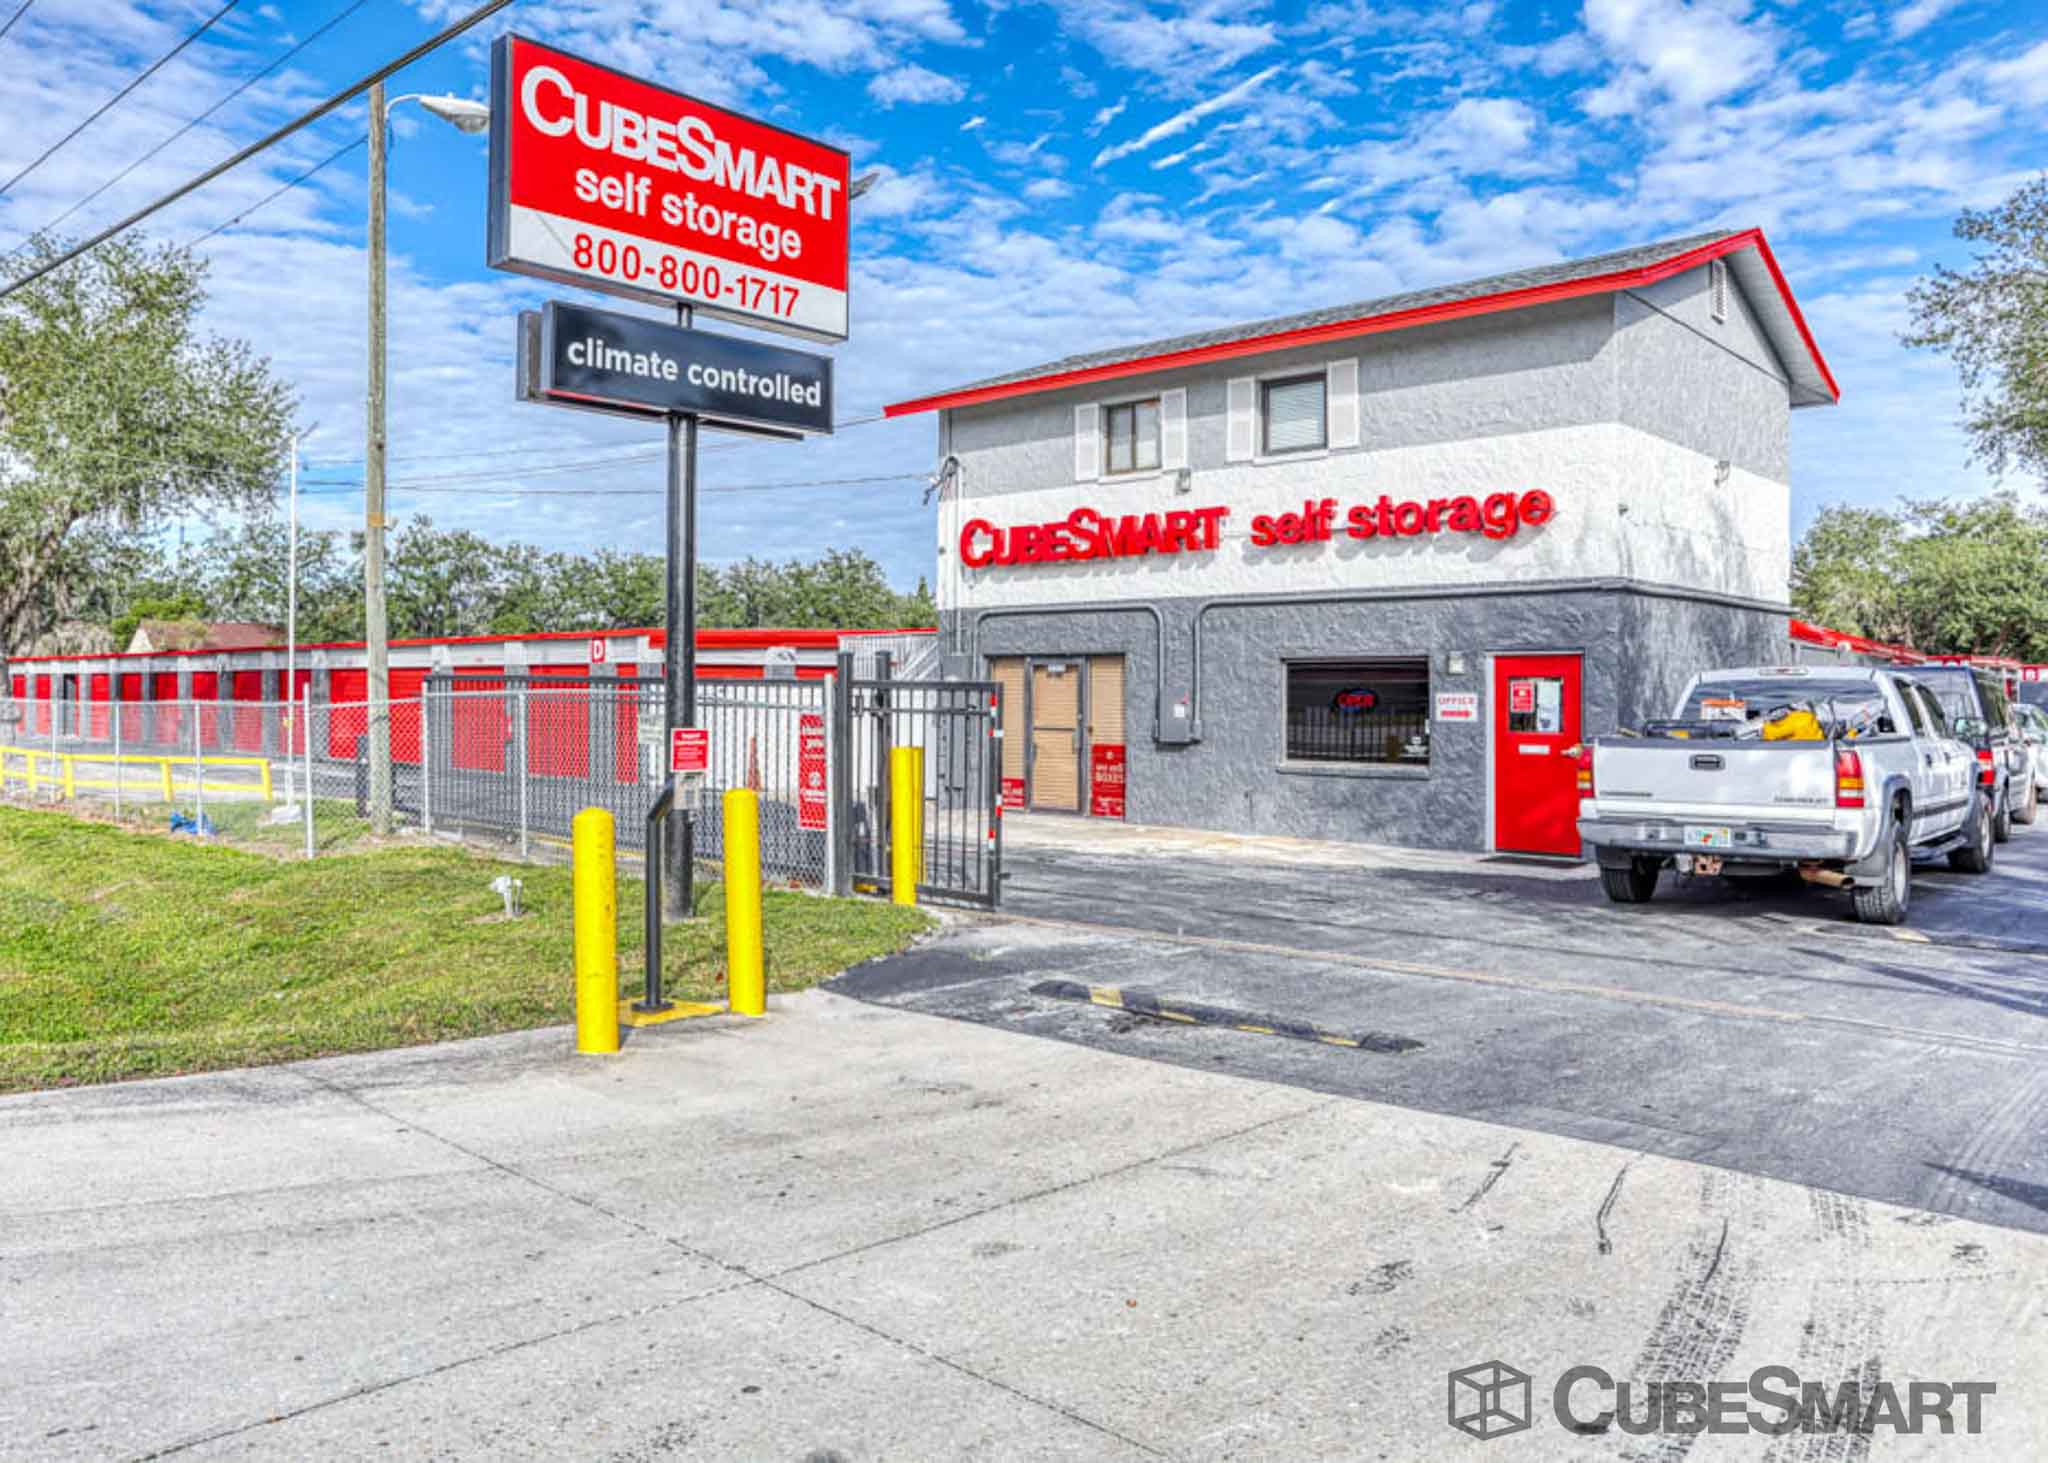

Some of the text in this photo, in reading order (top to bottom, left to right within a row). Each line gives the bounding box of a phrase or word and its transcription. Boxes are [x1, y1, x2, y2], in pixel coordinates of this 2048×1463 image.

[574, 167, 802, 262] self storage
[572, 232, 801, 318] 800-800-1717
[567, 338, 822, 407] climate controlled
[1251, 498, 1337, 546] self
[1346, 489, 1555, 540] storage
[1437, 696, 1475, 706] OFFICE
